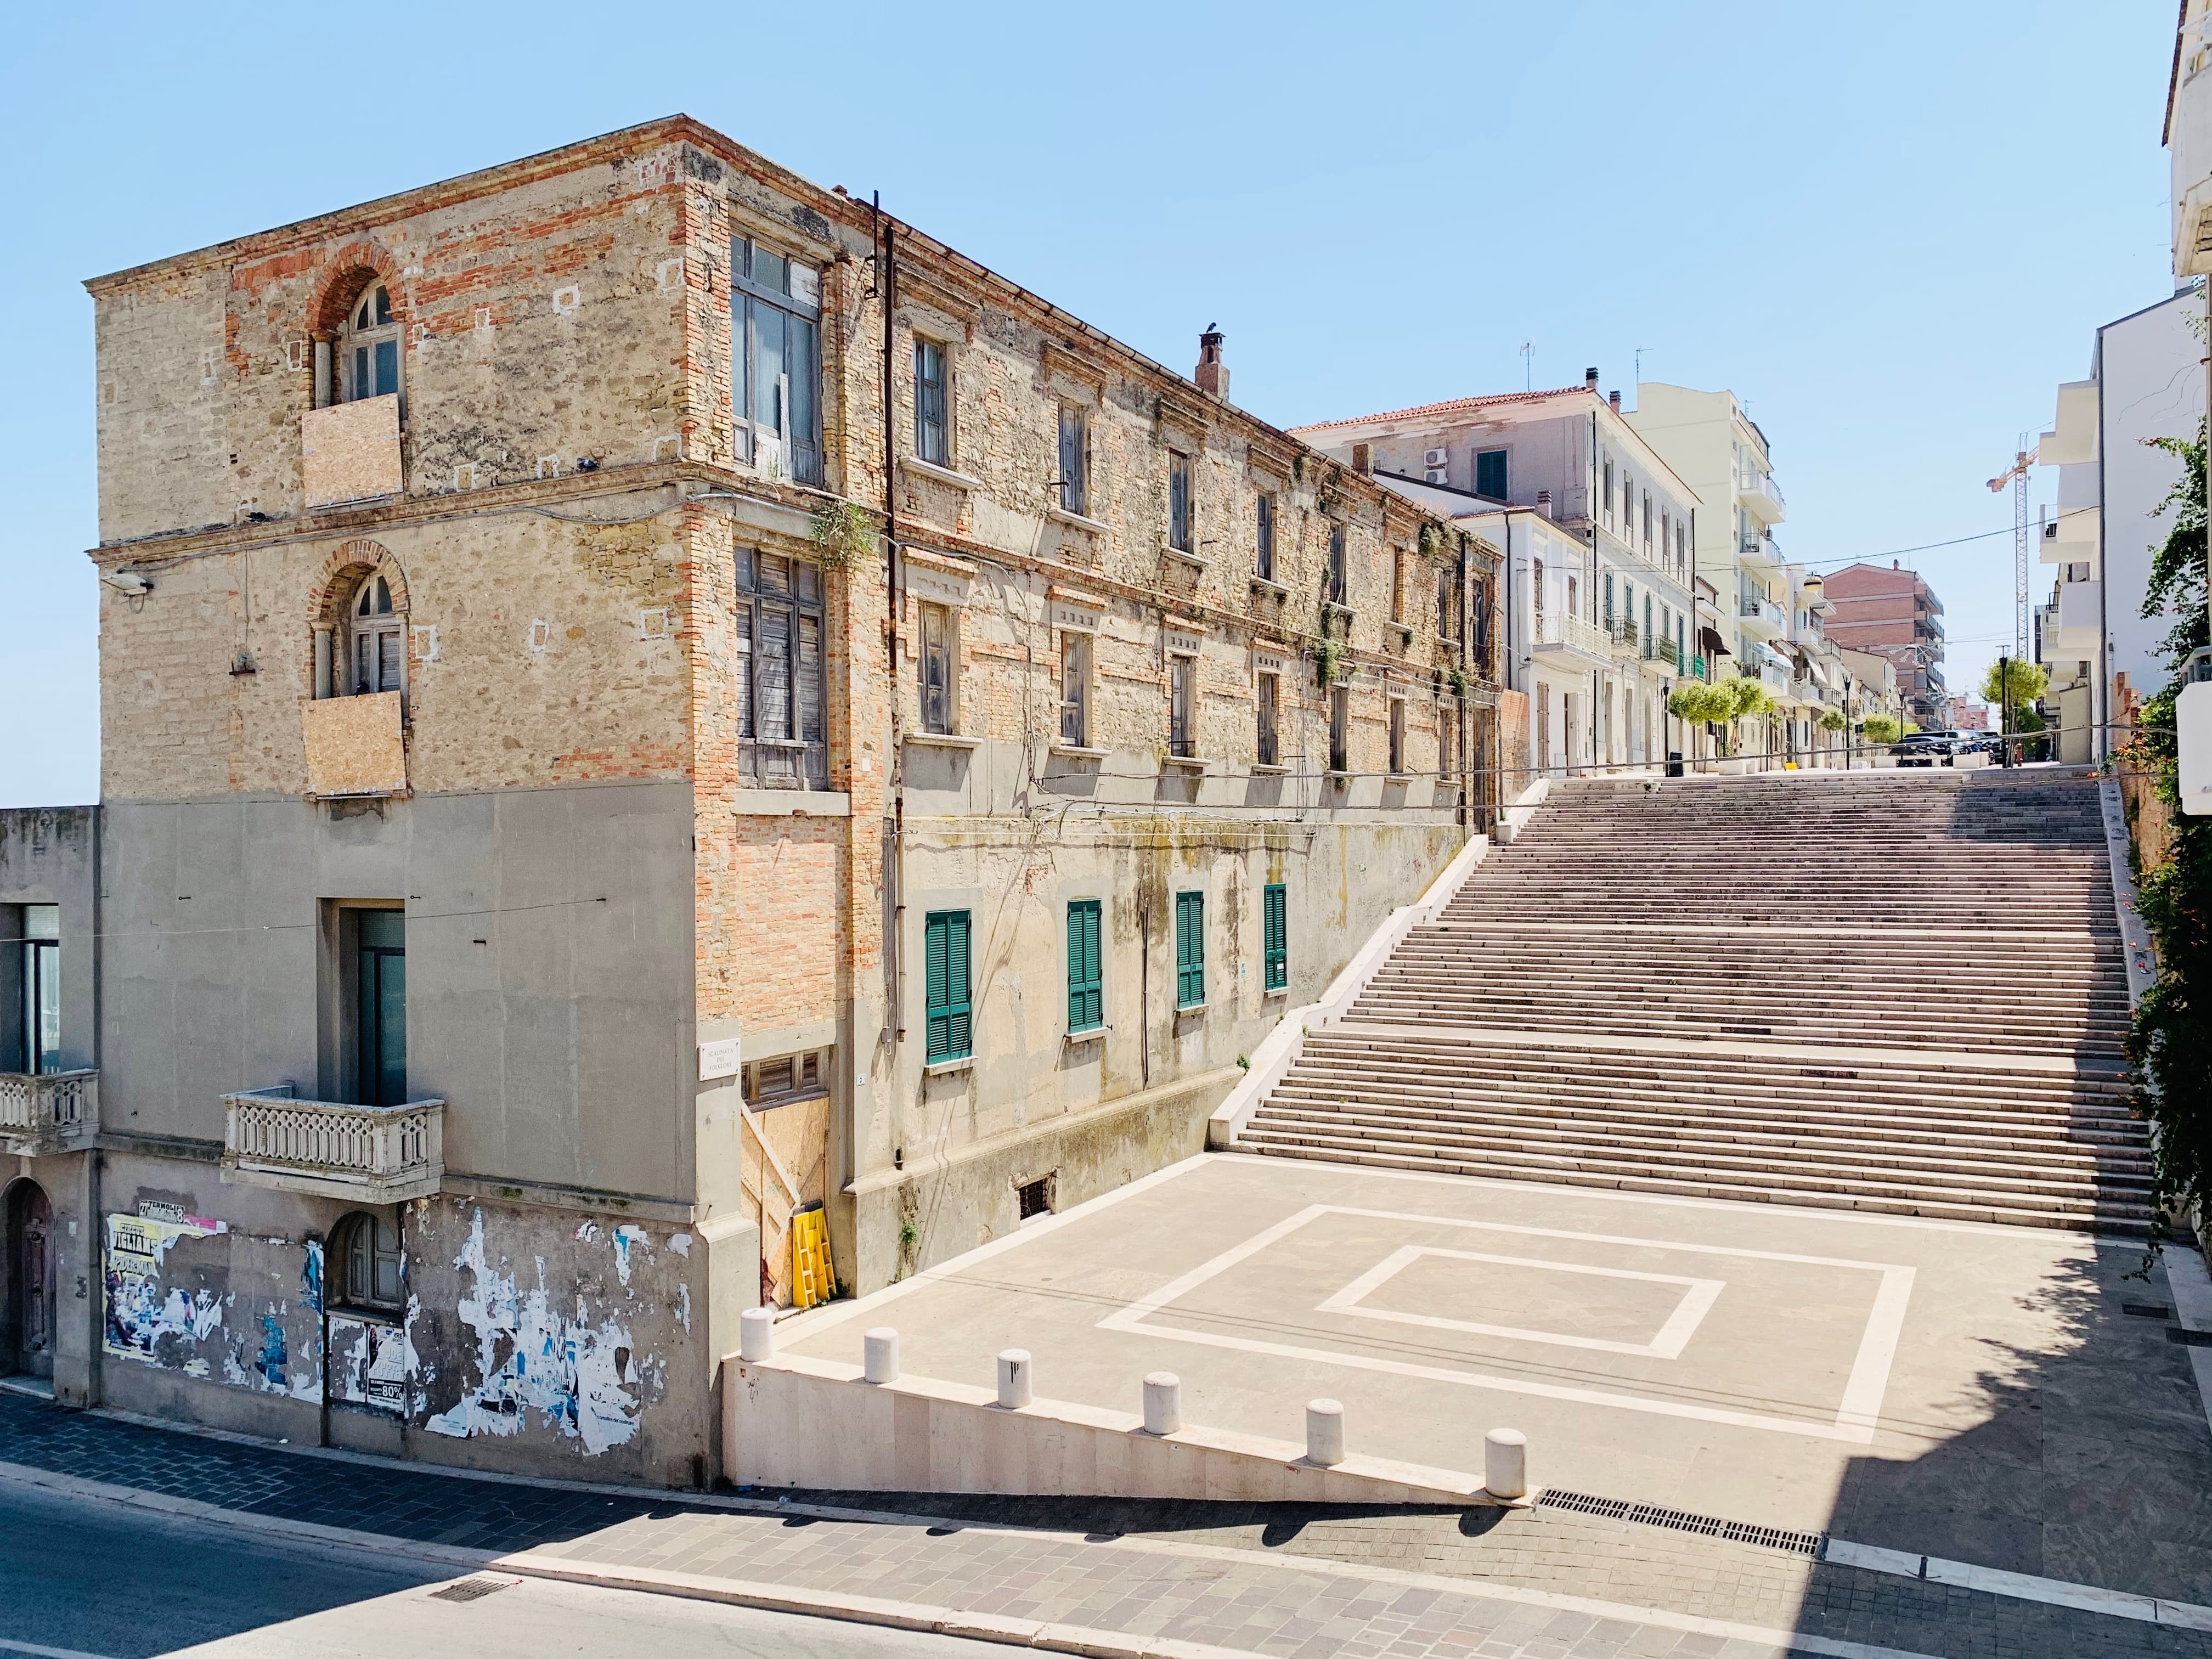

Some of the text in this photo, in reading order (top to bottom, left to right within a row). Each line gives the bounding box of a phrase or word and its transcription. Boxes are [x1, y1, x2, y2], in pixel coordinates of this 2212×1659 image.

[708, 1048, 733, 1057] SCALINATA
[709, 1062, 732, 1071] FOLKLORE
[148, 1201, 176, 1211] TERMOLI
[120, 1222, 144, 1237] CIRCUS
[382, 1385, 403, 1399] 80%
